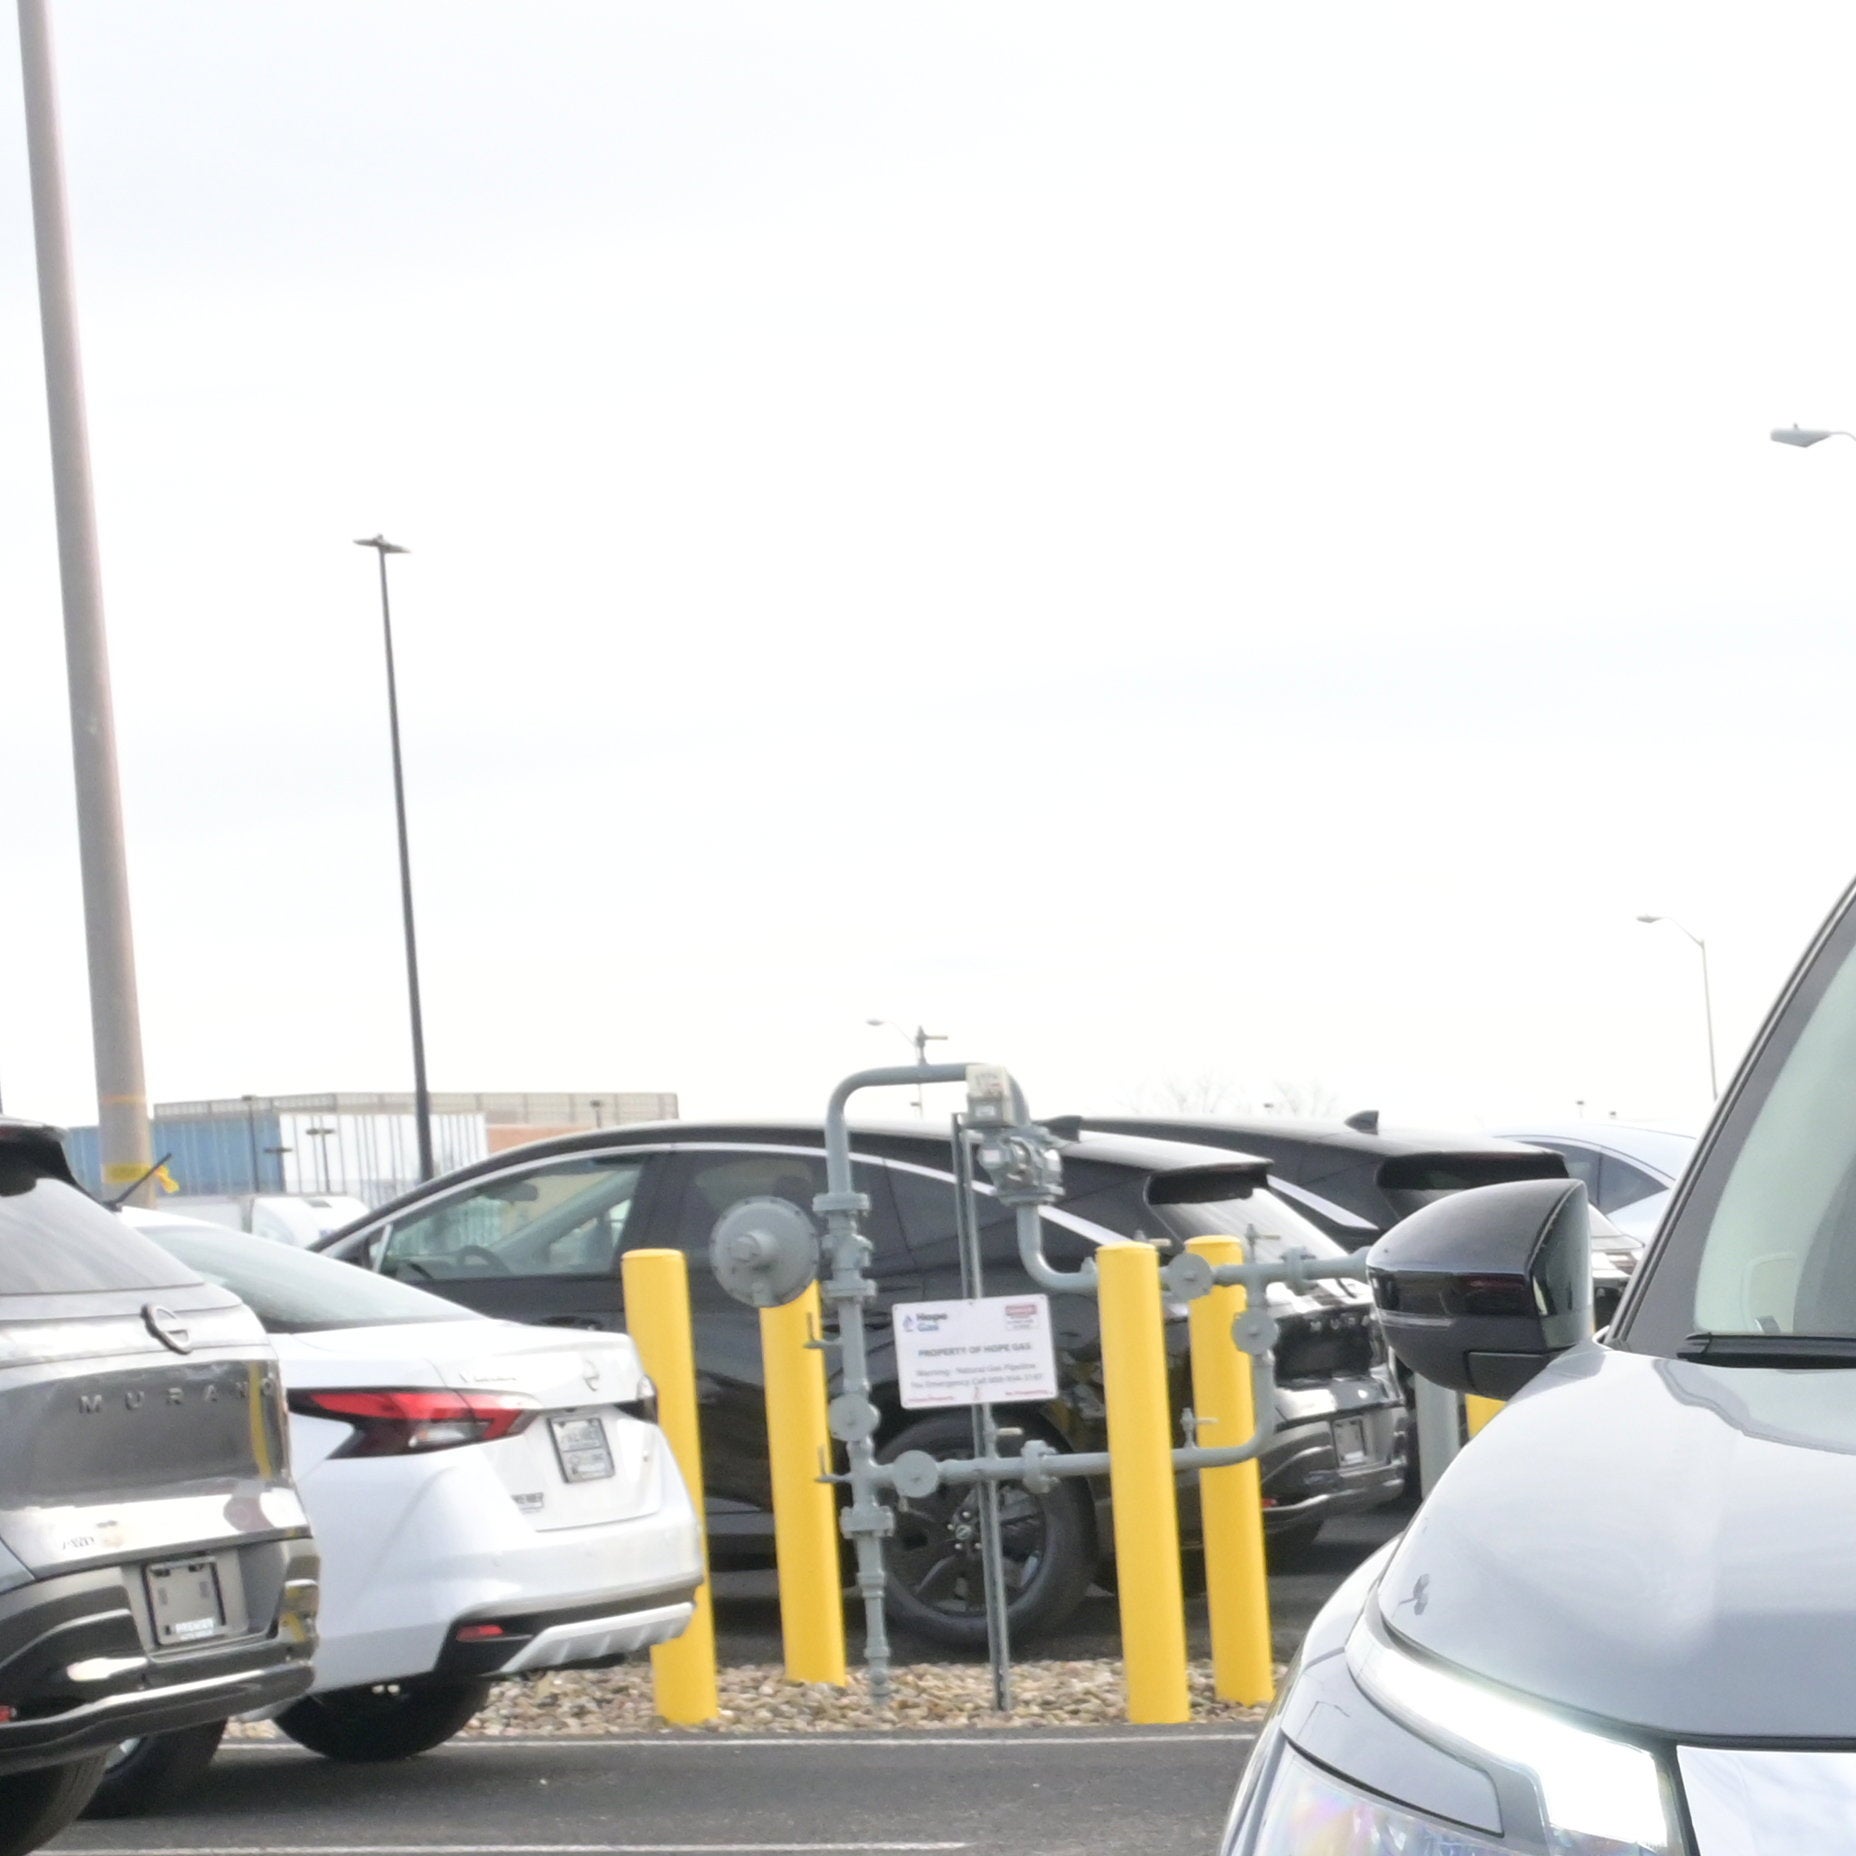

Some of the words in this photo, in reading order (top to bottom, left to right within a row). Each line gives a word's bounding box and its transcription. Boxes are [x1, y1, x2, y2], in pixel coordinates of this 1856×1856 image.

[916, 1313, 948, 1322] Hope
[917, 1323, 939, 1332] Gas
[918, 1347, 966, 1357] PROPERTY
[969, 1346, 981, 1354] OF
[1012, 1342, 1031, 1351] GAS
